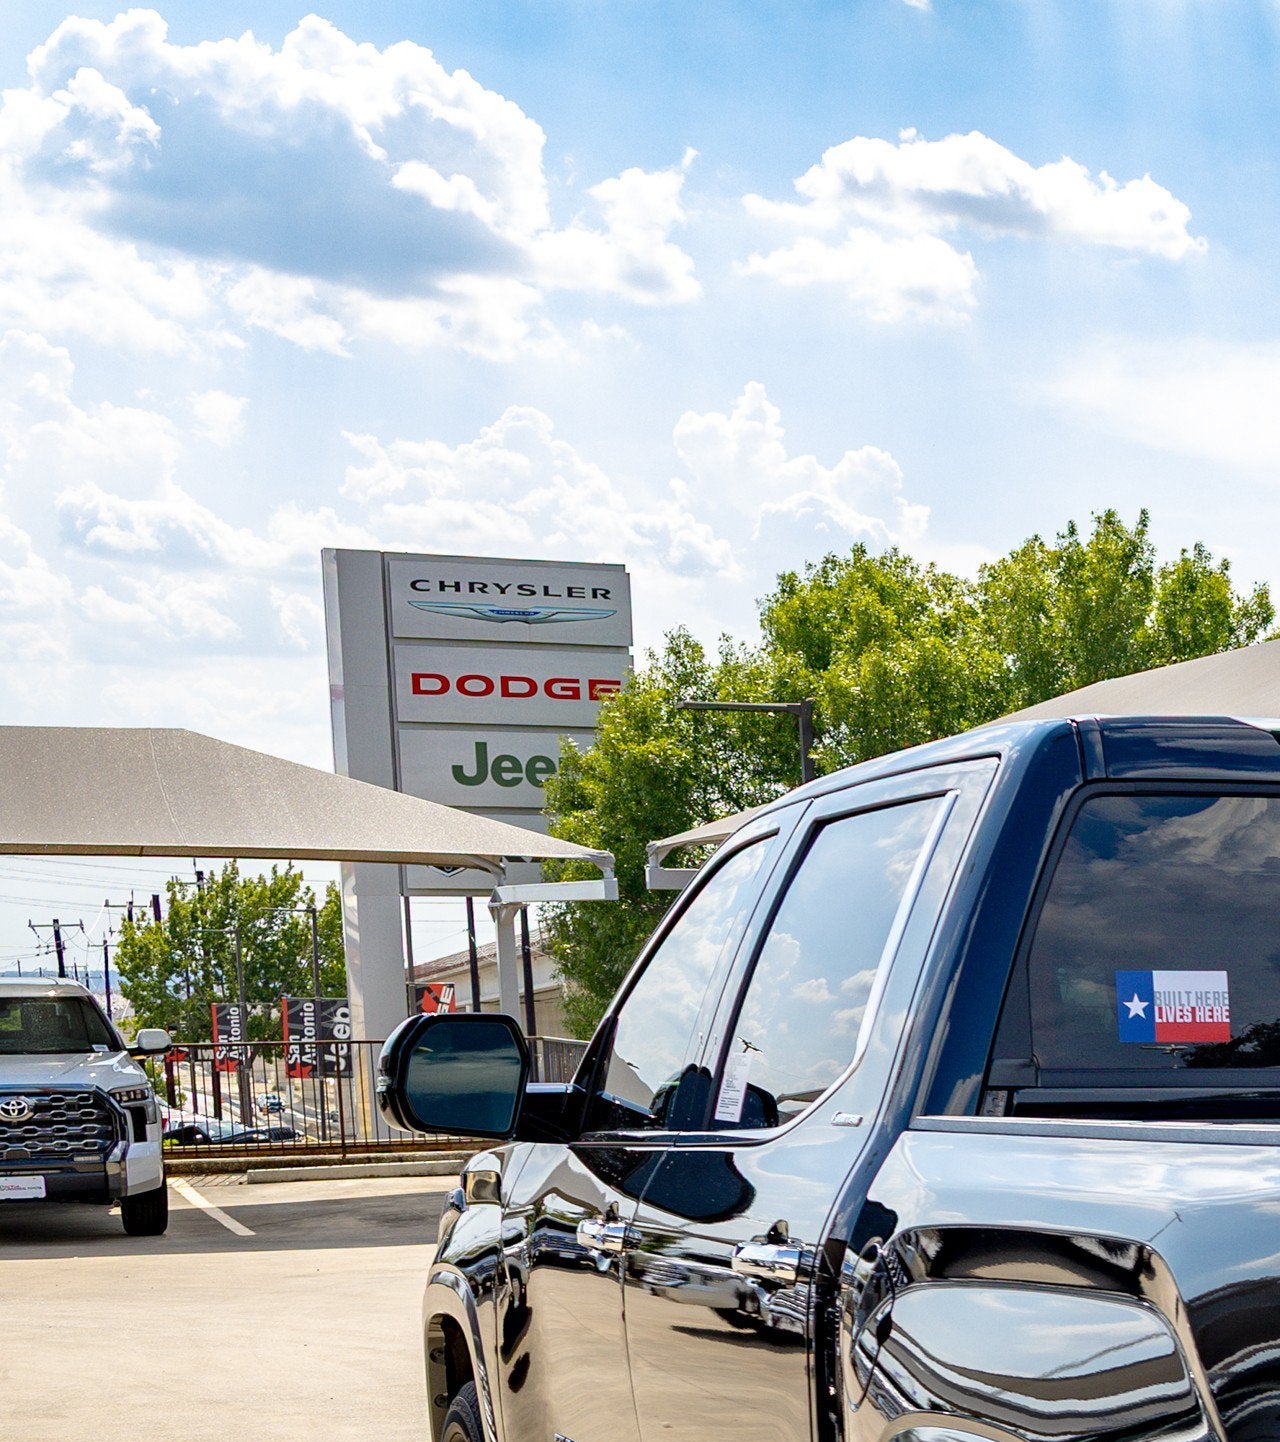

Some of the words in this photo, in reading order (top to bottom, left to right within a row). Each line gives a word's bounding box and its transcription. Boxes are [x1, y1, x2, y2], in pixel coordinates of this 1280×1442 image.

[410, 578, 612, 600] CHRYSLER
[411, 672, 622, 701] DODGE
[451, 741, 564, 788] Jee
[1154, 990, 1192, 1007] BUILT
[1195, 990, 1229, 1007] HERE
[1154, 1006, 1192, 1023] LIVES
[1195, 1006, 1230, 1023] HERE
[300, 1002, 317, 1065] Antonio
[288, 1034, 300, 1065] San
